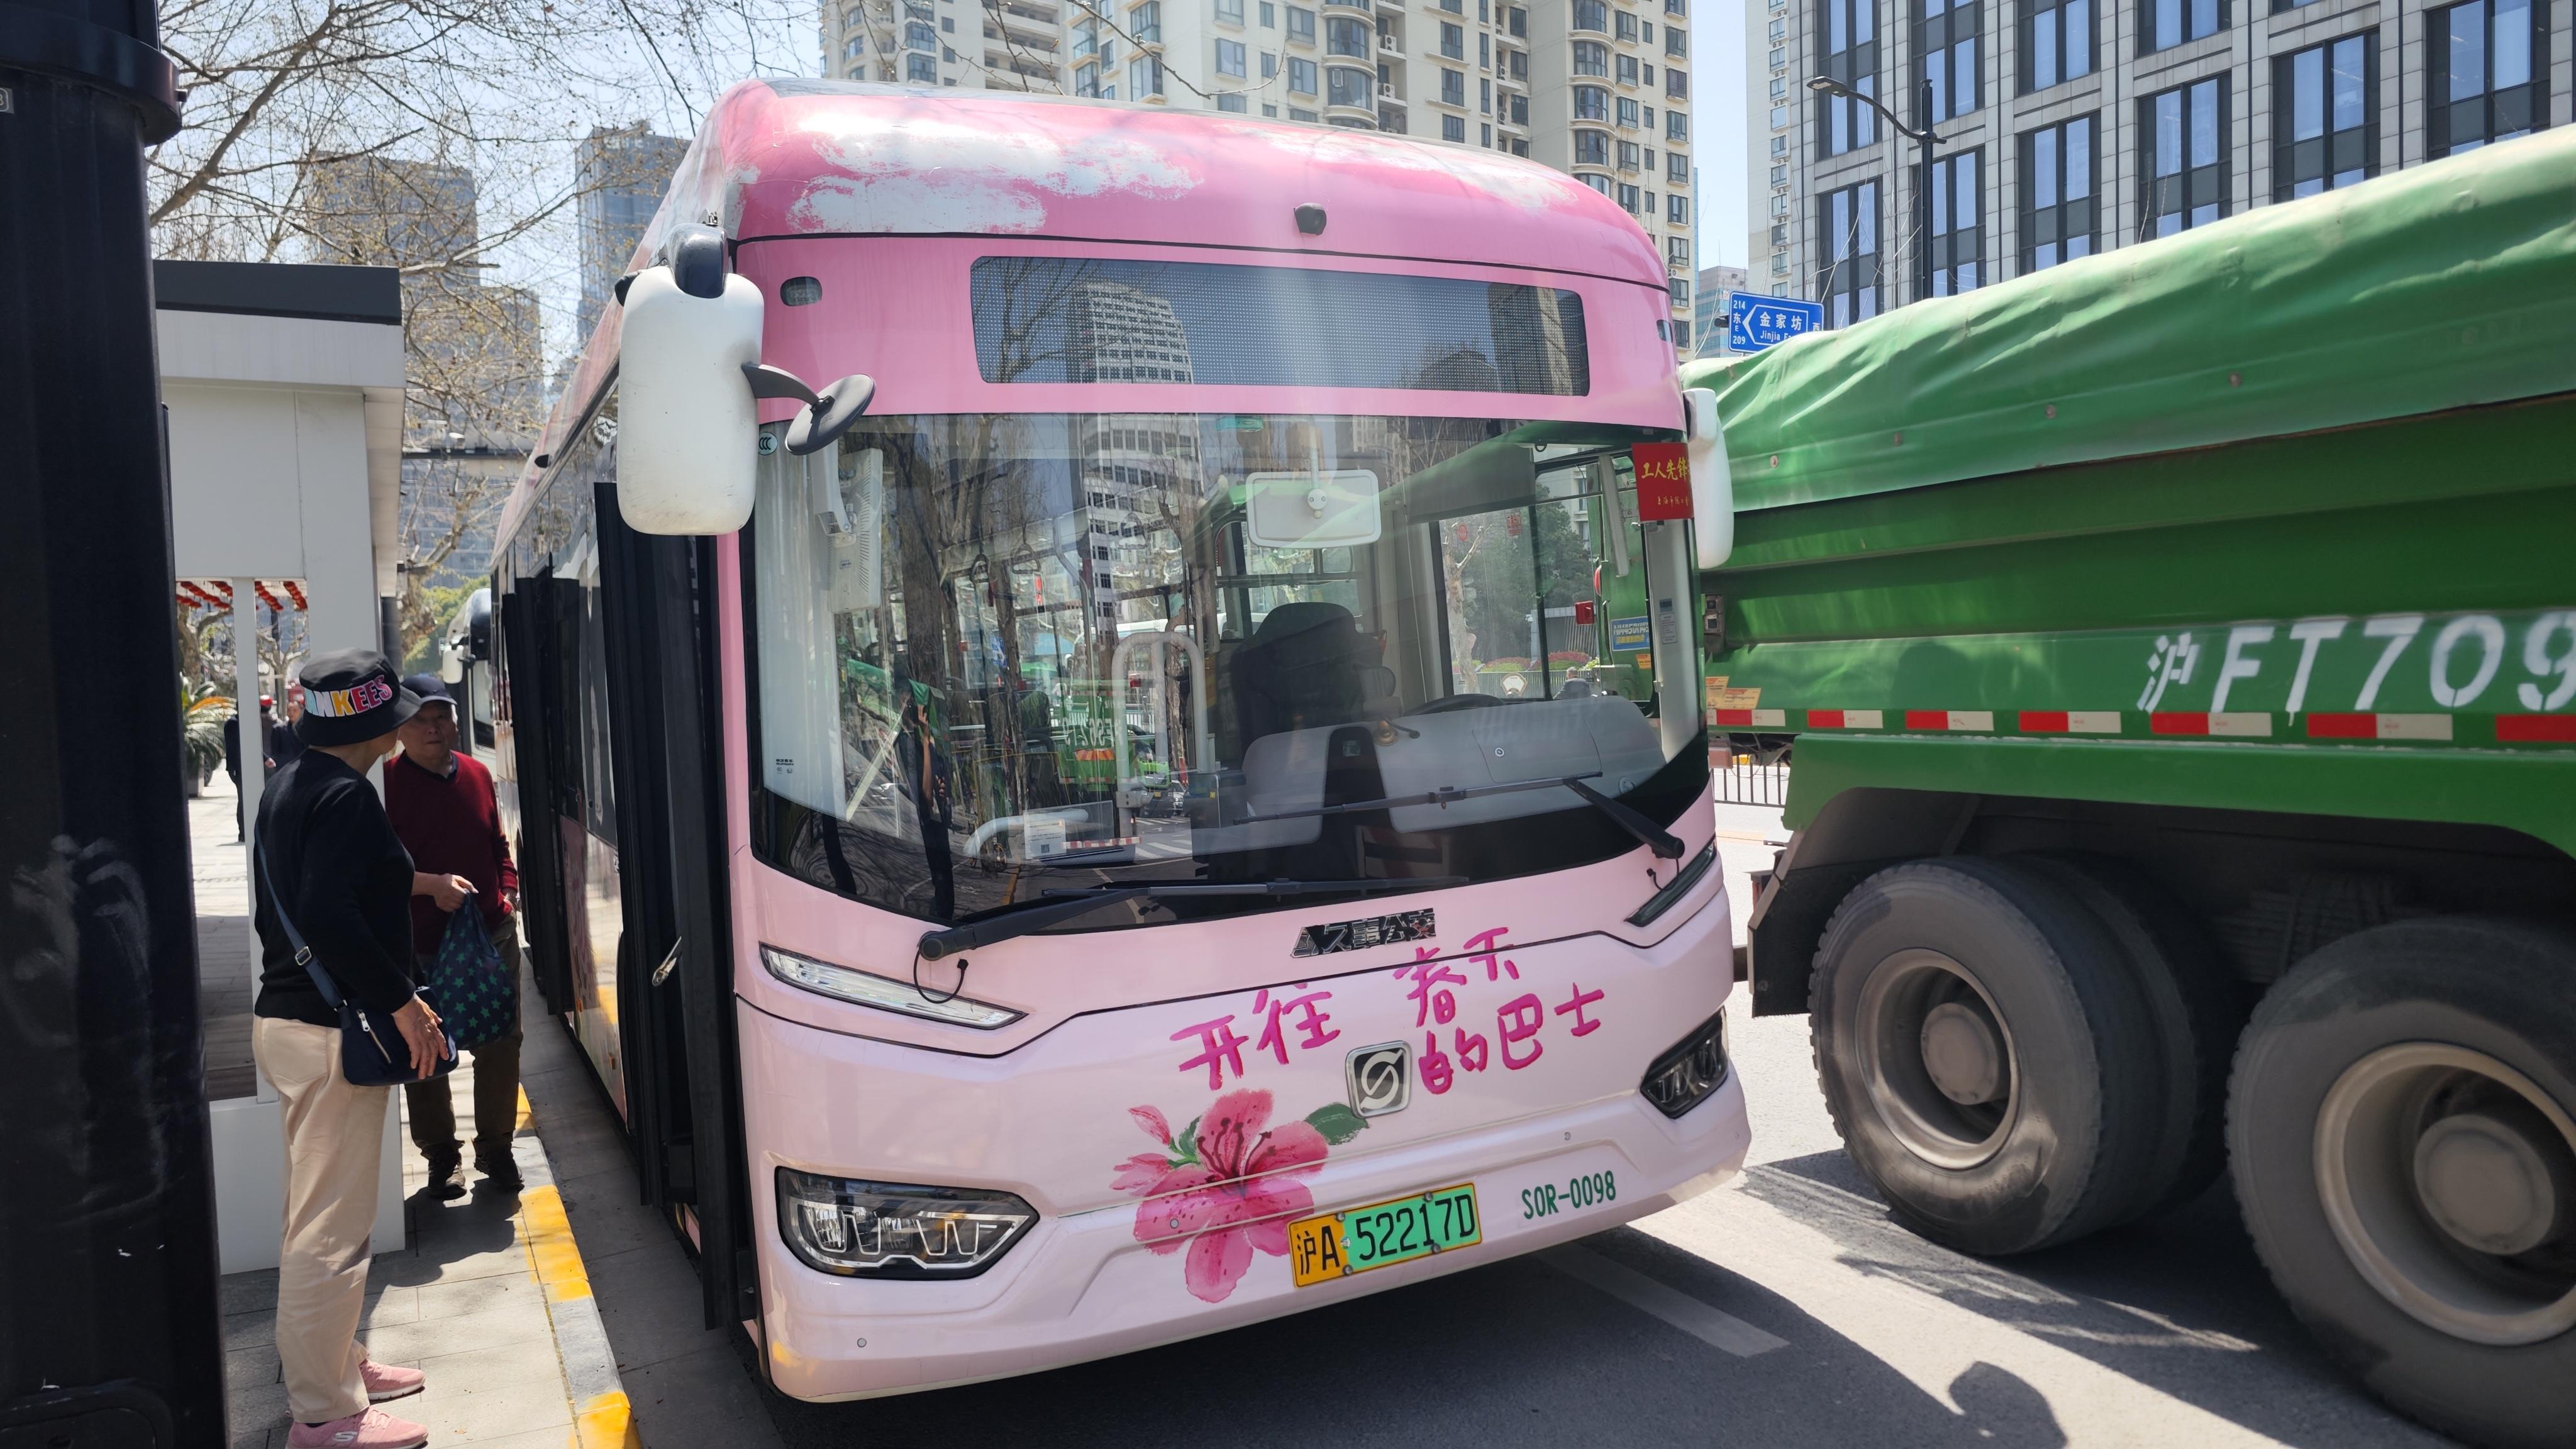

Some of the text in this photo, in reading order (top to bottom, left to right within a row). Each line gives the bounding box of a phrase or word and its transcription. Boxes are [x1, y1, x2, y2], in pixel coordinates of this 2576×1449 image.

[1733, 300, 1745, 309] 214
[1733, 312, 1741, 324] 东
[1760, 311, 1802, 331] 金家坊
[1733, 336, 1746, 345] 209
[1760, 330, 1780, 343] Jinjia
[1641, 457, 1690, 482] 工人先锋
[1170, 982, 1341, 1091] 开往
[1418, 982, 1604, 1095] 的巴士
[1521, 1170, 1616, 1219] SOR-0098
